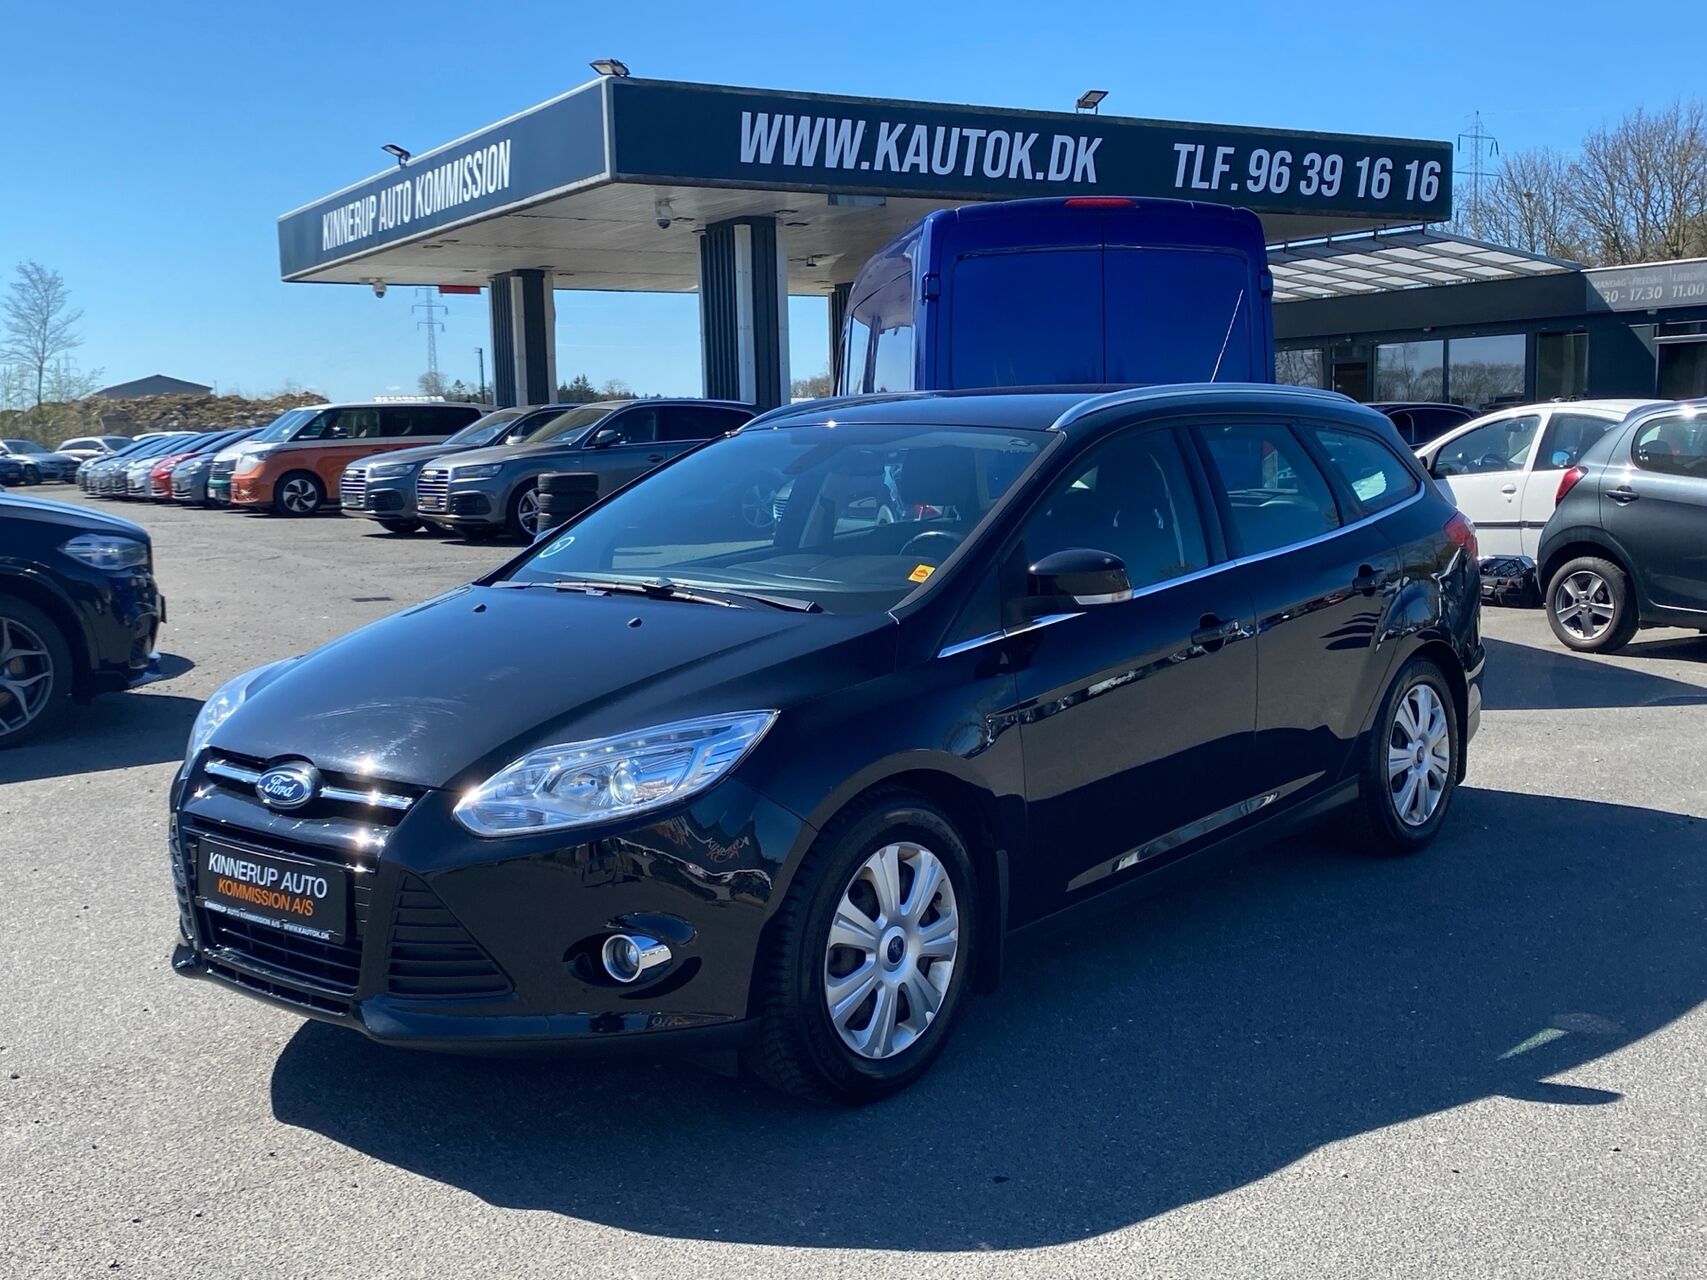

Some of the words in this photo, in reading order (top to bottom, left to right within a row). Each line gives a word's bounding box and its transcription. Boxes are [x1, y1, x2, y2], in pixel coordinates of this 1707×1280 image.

[740, 111, 1102, 184] WWW.KAUTOK.DK
[322, 194, 377, 252] KINNERUP
[378, 180, 411, 232] AUTO
[414, 139, 512, 220] KOMMISSION
[1173, 143, 1239, 191] TLF.
[1246, 148, 1293, 194] 96
[1299, 152, 1344, 197] 39
[1356, 156, 1393, 199] 16
[1405, 160, 1441, 202] 16
[1629, 286, 1664, 301] 17.30
[264, 774, 299, 798] Ford
[208, 852, 278, 887] KINNERUP
[280, 871, 328, 898] AUTO
[218, 878, 290, 911] KOMMISSION
[292, 898, 314, 917] A/S
